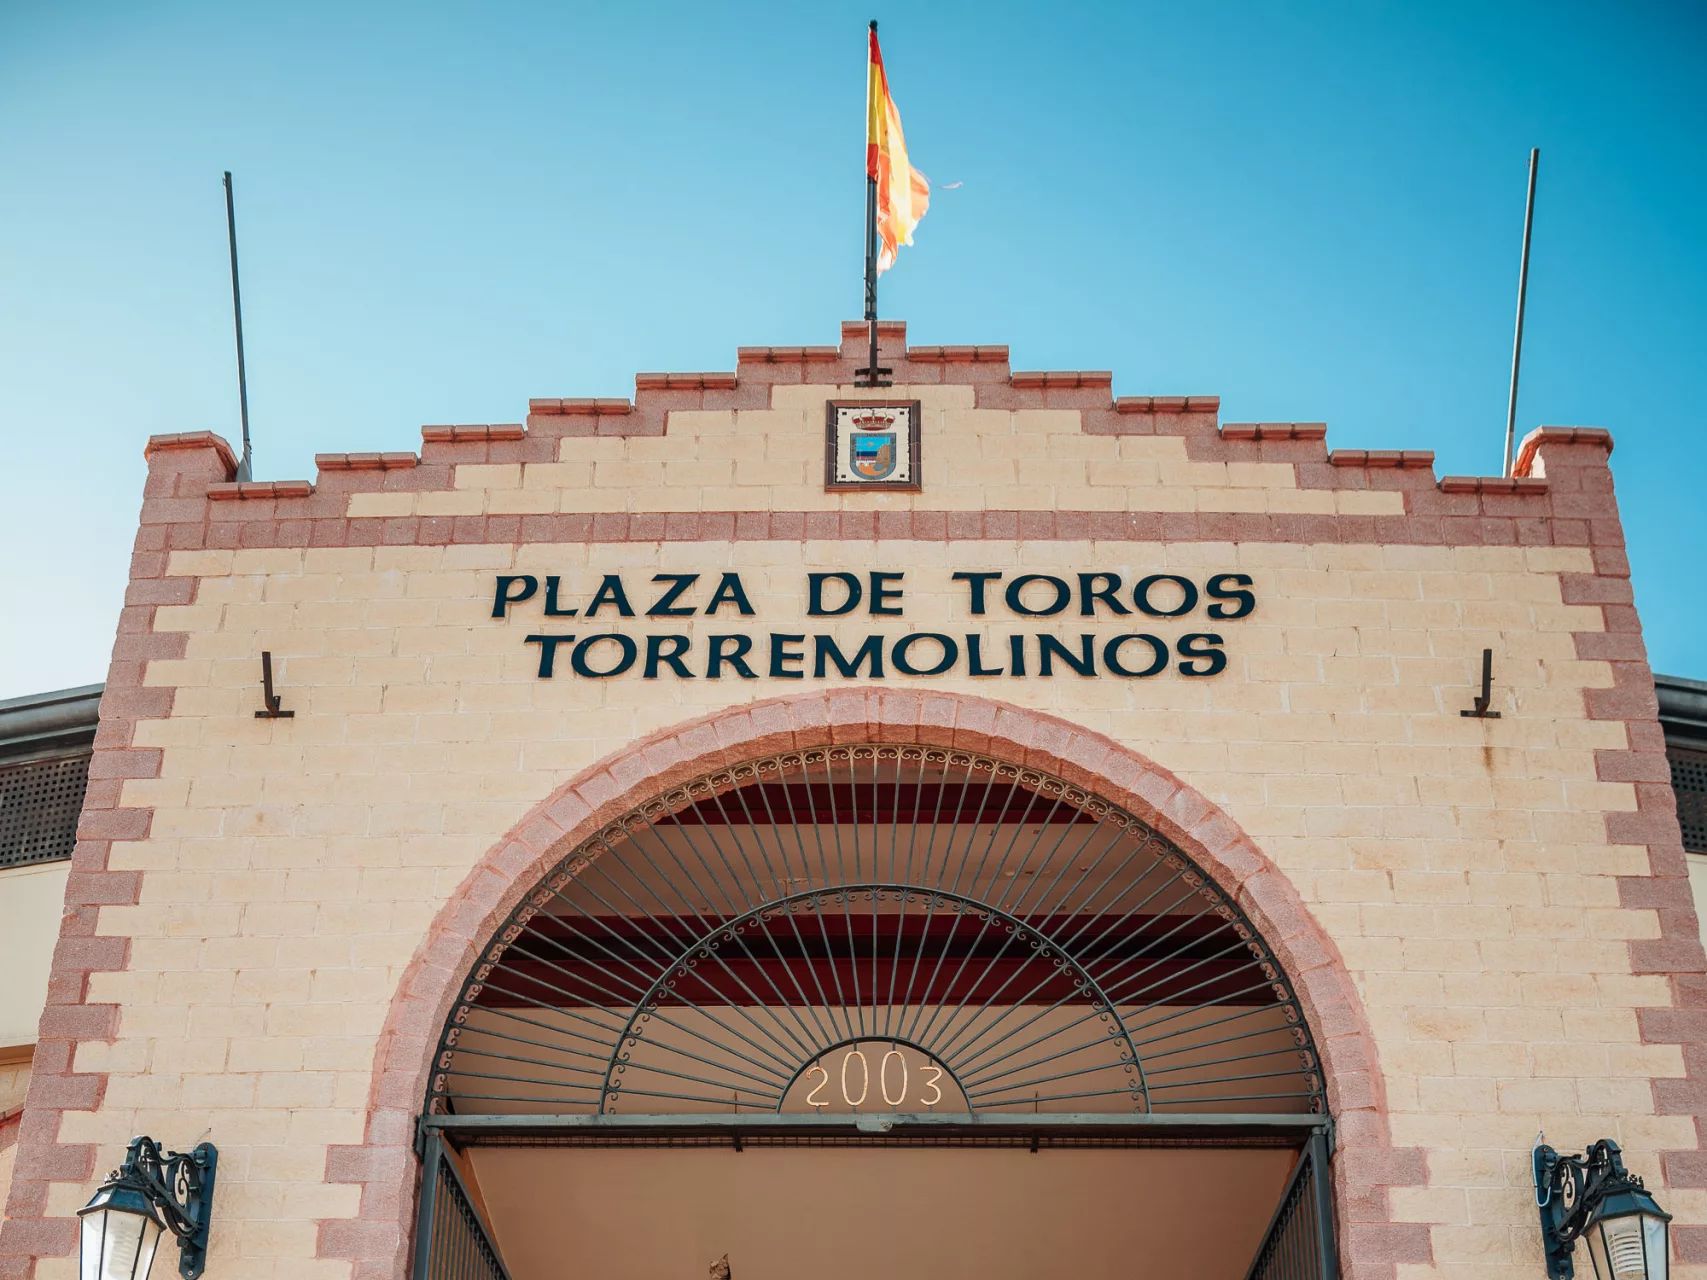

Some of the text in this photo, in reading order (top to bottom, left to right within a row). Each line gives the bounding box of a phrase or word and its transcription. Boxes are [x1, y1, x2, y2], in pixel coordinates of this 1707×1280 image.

[491, 571, 1256, 620] PLAZA DE TOROS
[524, 632, 1228, 679] TORREMOLINOS
[806, 1050, 942, 1106] 2003
